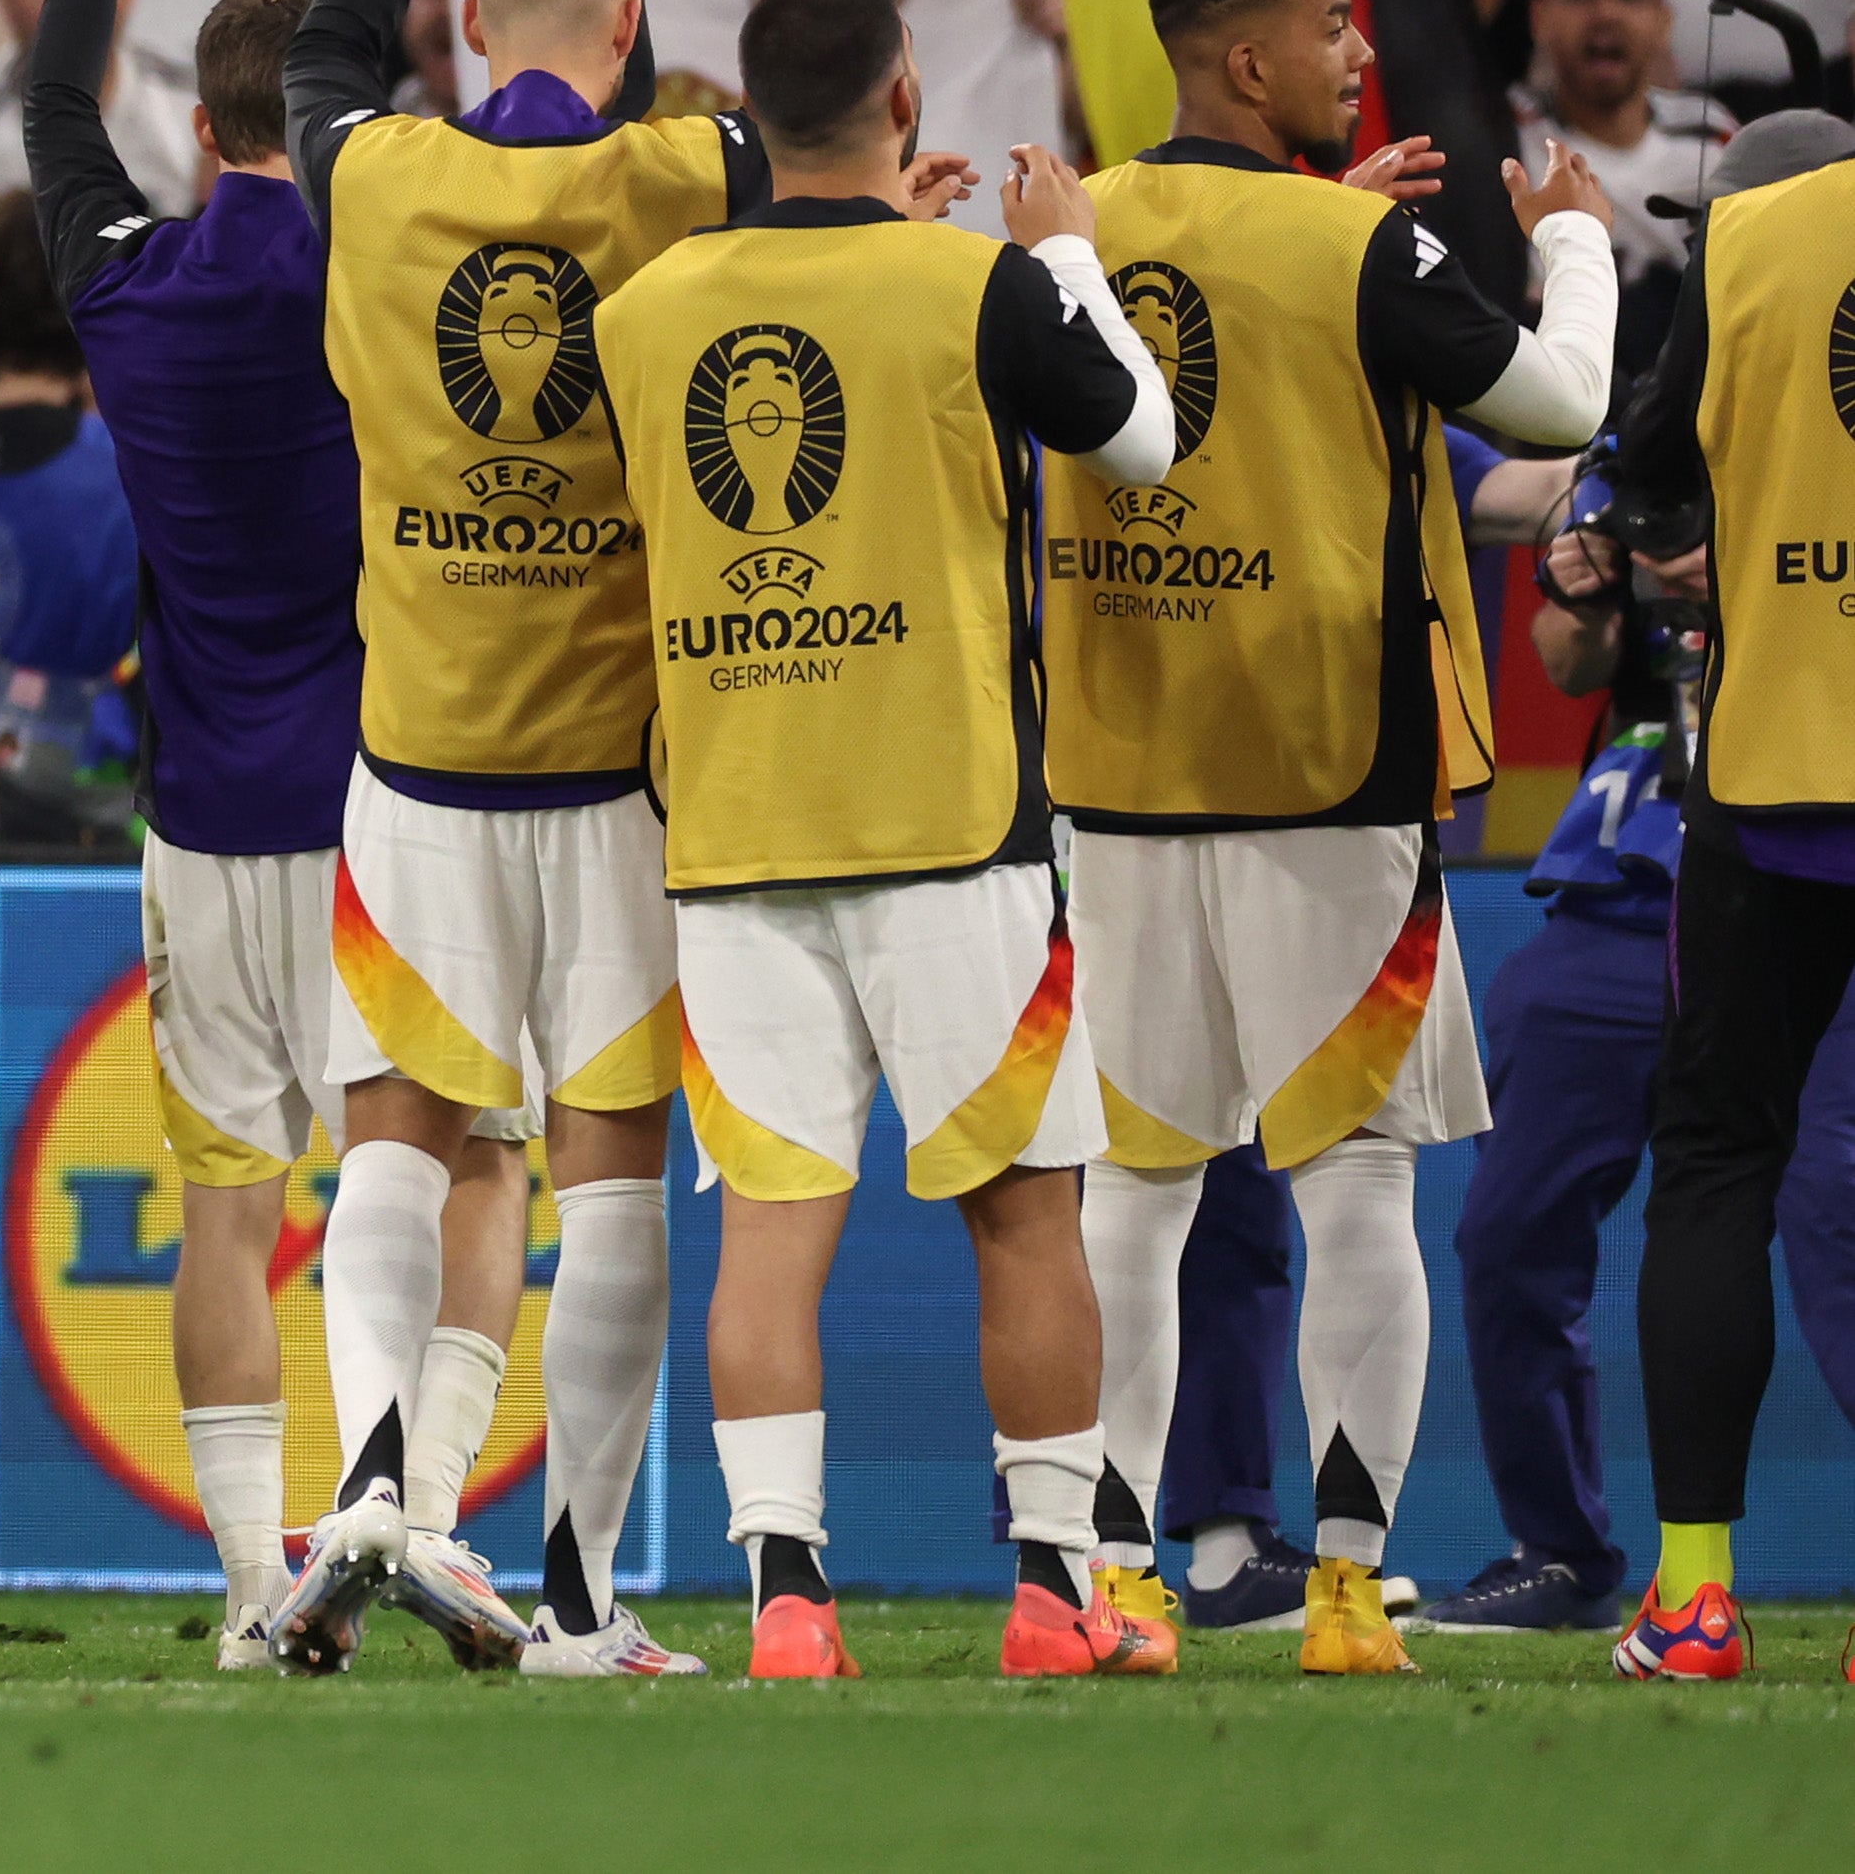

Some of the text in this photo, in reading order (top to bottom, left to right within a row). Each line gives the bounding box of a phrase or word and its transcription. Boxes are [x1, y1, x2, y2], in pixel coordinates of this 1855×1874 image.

[465, 464, 563, 503] UEFA
[1109, 491, 1186, 530] UEFA
[441, 560, 590, 588] GERMANY
[726, 557, 815, 595] UEFA
[1048, 538, 1275, 591] EURO2024
[1093, 592, 1215, 622] GERMANY
[666, 601, 909, 661] EURO2024
[709, 657, 844, 692] GERMANY
